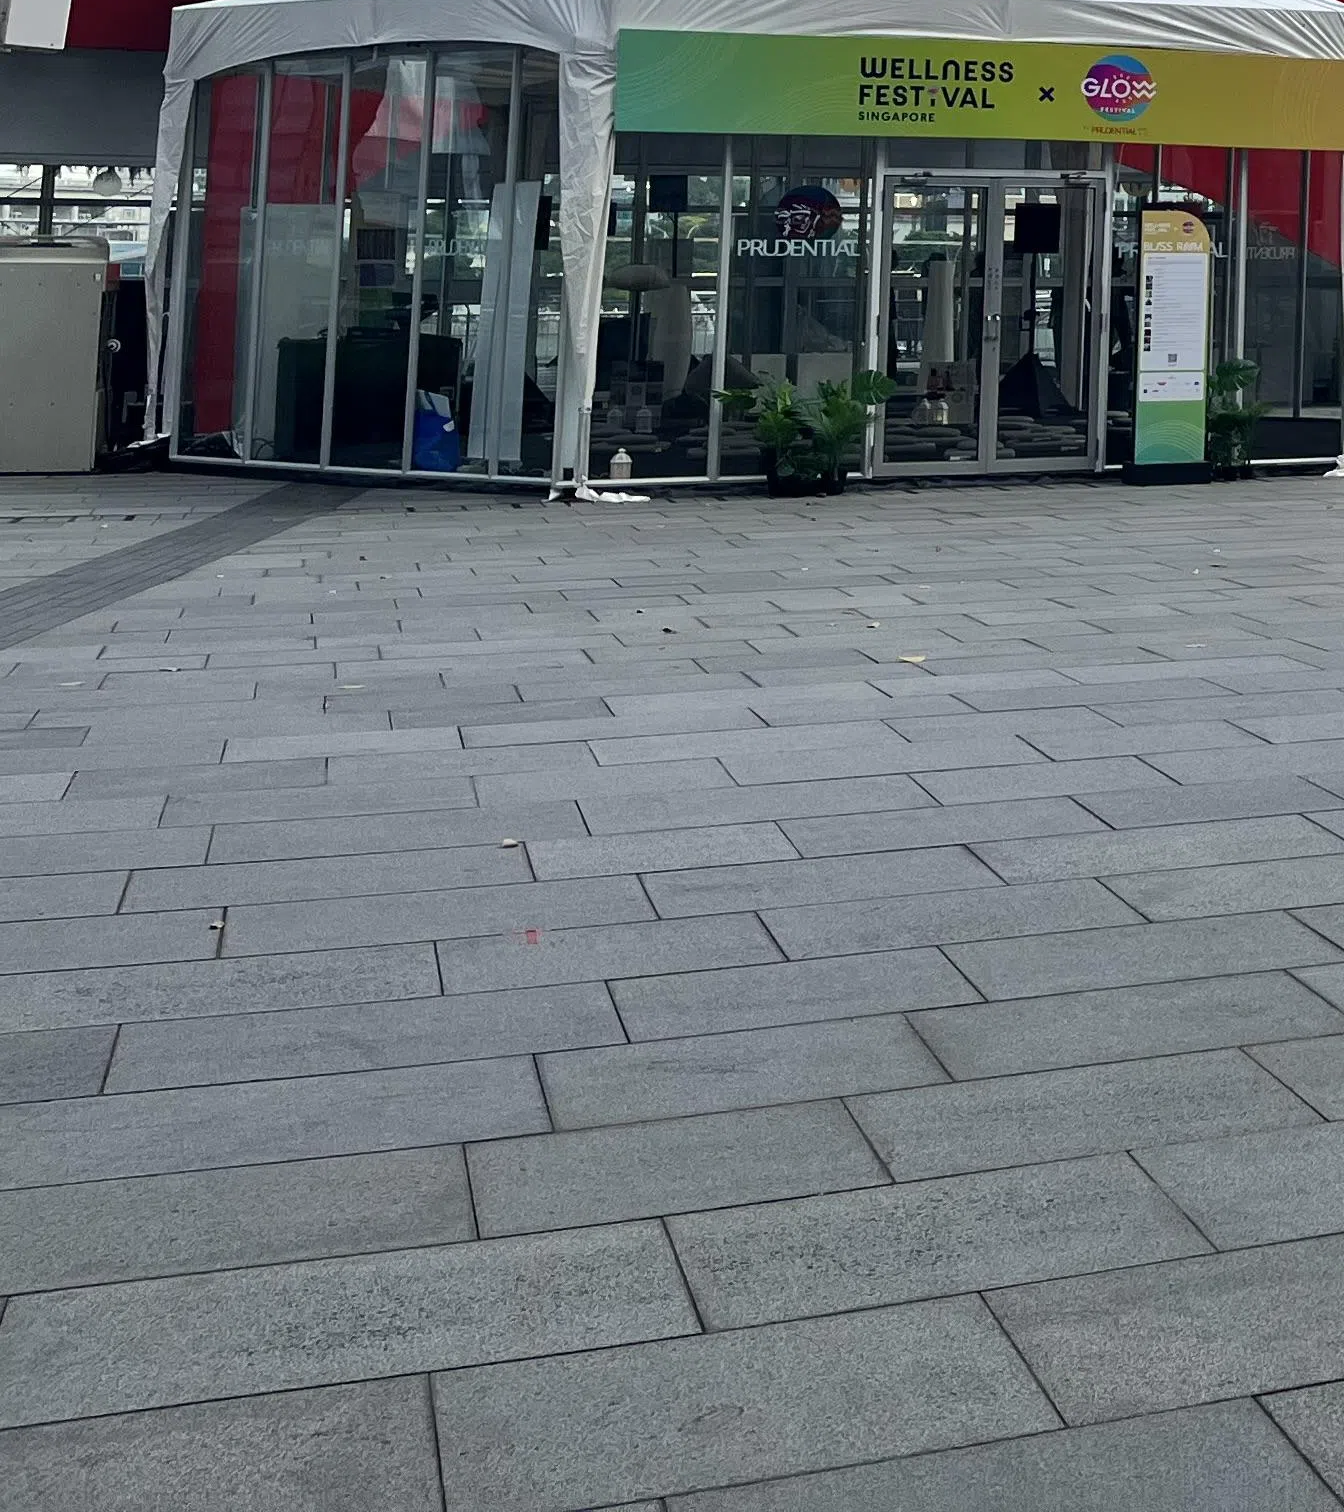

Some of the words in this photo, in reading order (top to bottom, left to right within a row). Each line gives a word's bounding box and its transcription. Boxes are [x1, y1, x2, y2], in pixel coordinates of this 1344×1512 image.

[860, 56, 1014, 82] WELLNESS
[858, 84, 995, 109] FESTIVAL
[1080, 77, 1157, 100] GLOW
[858, 111, 935, 122] SINGAPORE
[737, 239, 861, 257] PRUDENTIAL
[1143, 241, 1173, 252] BLISS
